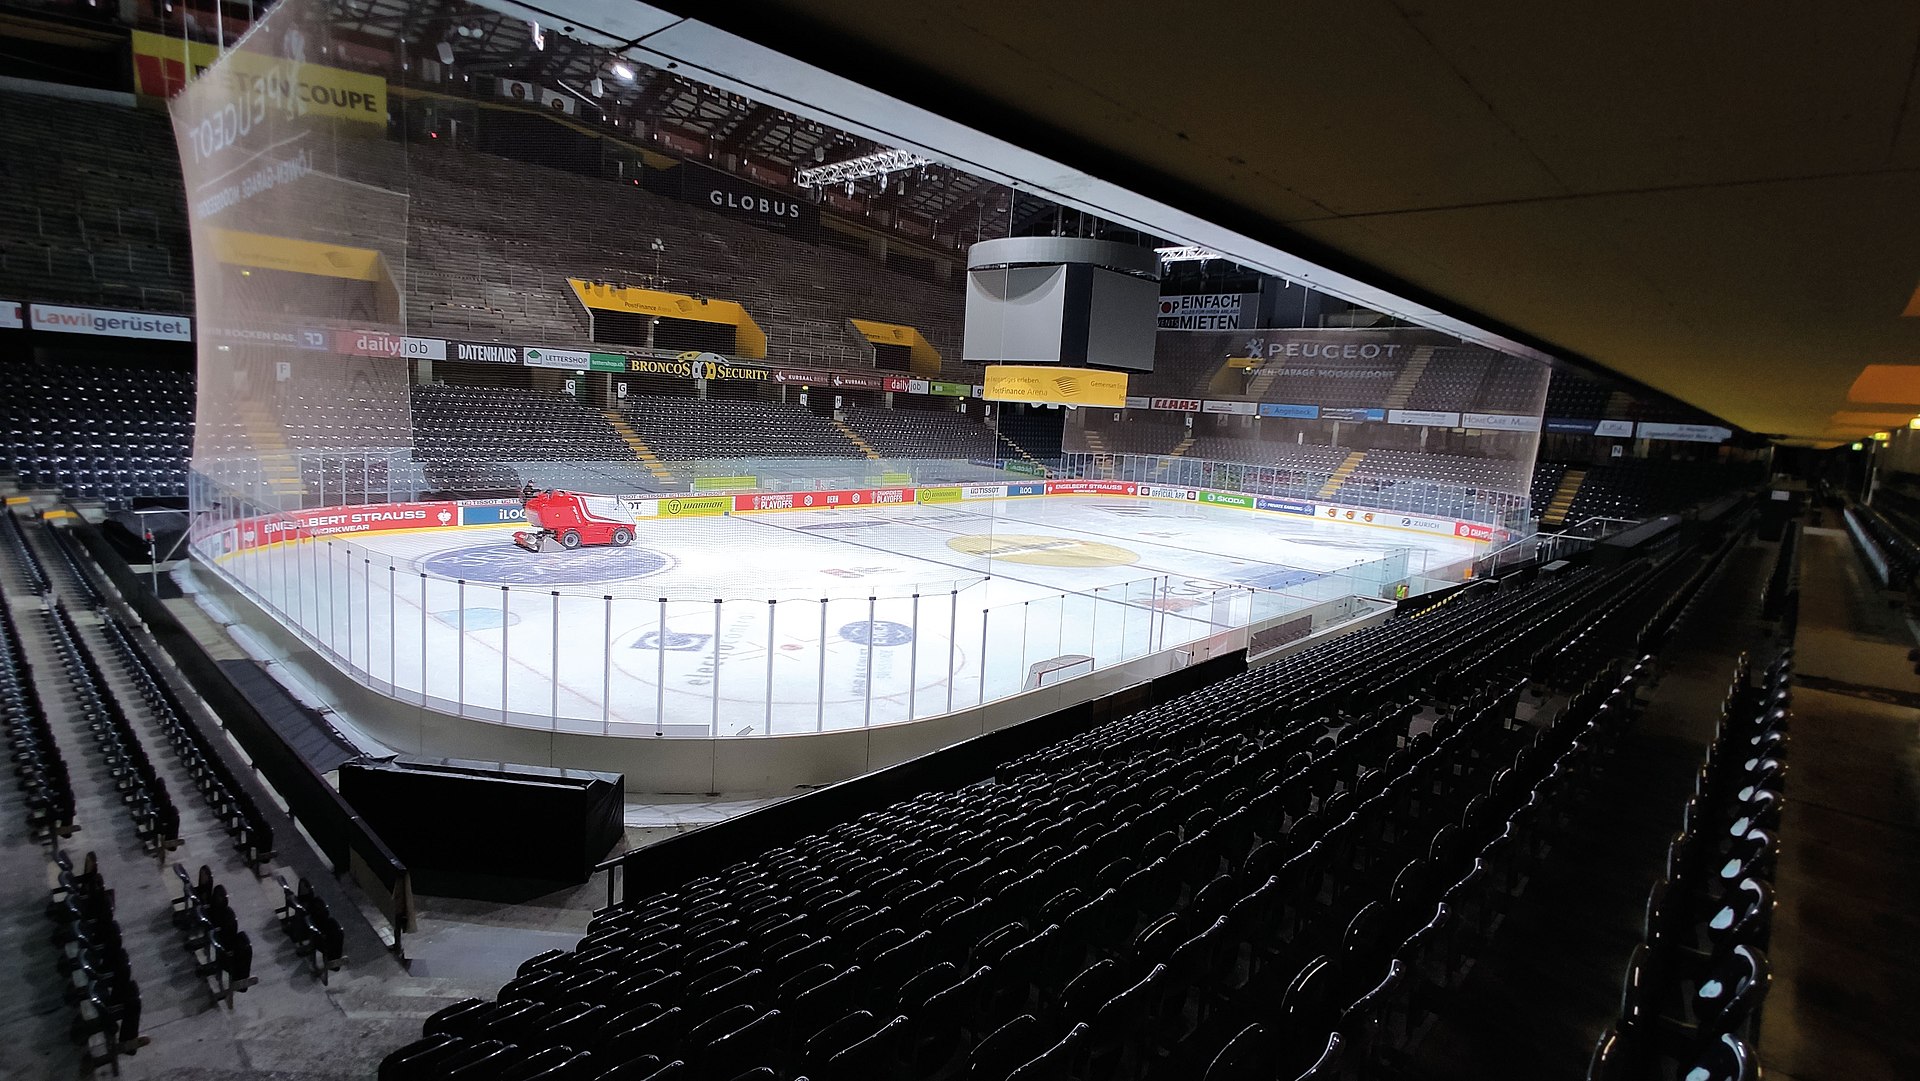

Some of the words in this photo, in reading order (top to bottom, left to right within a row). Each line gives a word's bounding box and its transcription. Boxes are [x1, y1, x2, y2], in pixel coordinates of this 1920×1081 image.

[709, 189, 800, 219] GLOBUS
[1181, 294, 1241, 309] EINFACH
[34, 307, 189, 335] Lawilgerüstet.
[1179, 314, 1239, 330] MIETEN
[458, 344, 517, 363] DATENHAUS
[1268, 342, 1401, 360] PEUGEOT
[545, 354, 588, 364] LETTERSHOP
[631, 359, 691, 377] BRONCOS
[717, 365, 770, 381] SECURITY
[567, 381, 575, 390] G
[619, 384, 626, 392] G
[1154, 399, 1199, 411] CLAAS
[979, 486, 1000, 494] TISSOT
[1088, 483, 1123, 491] STRAUSS
[683, 501, 723, 509] WARRIOR
[760, 500, 793, 510] PLAYOFFS
[877, 494, 903, 504] PLAYOFFS
[350, 510, 426, 524] STRAUSS
